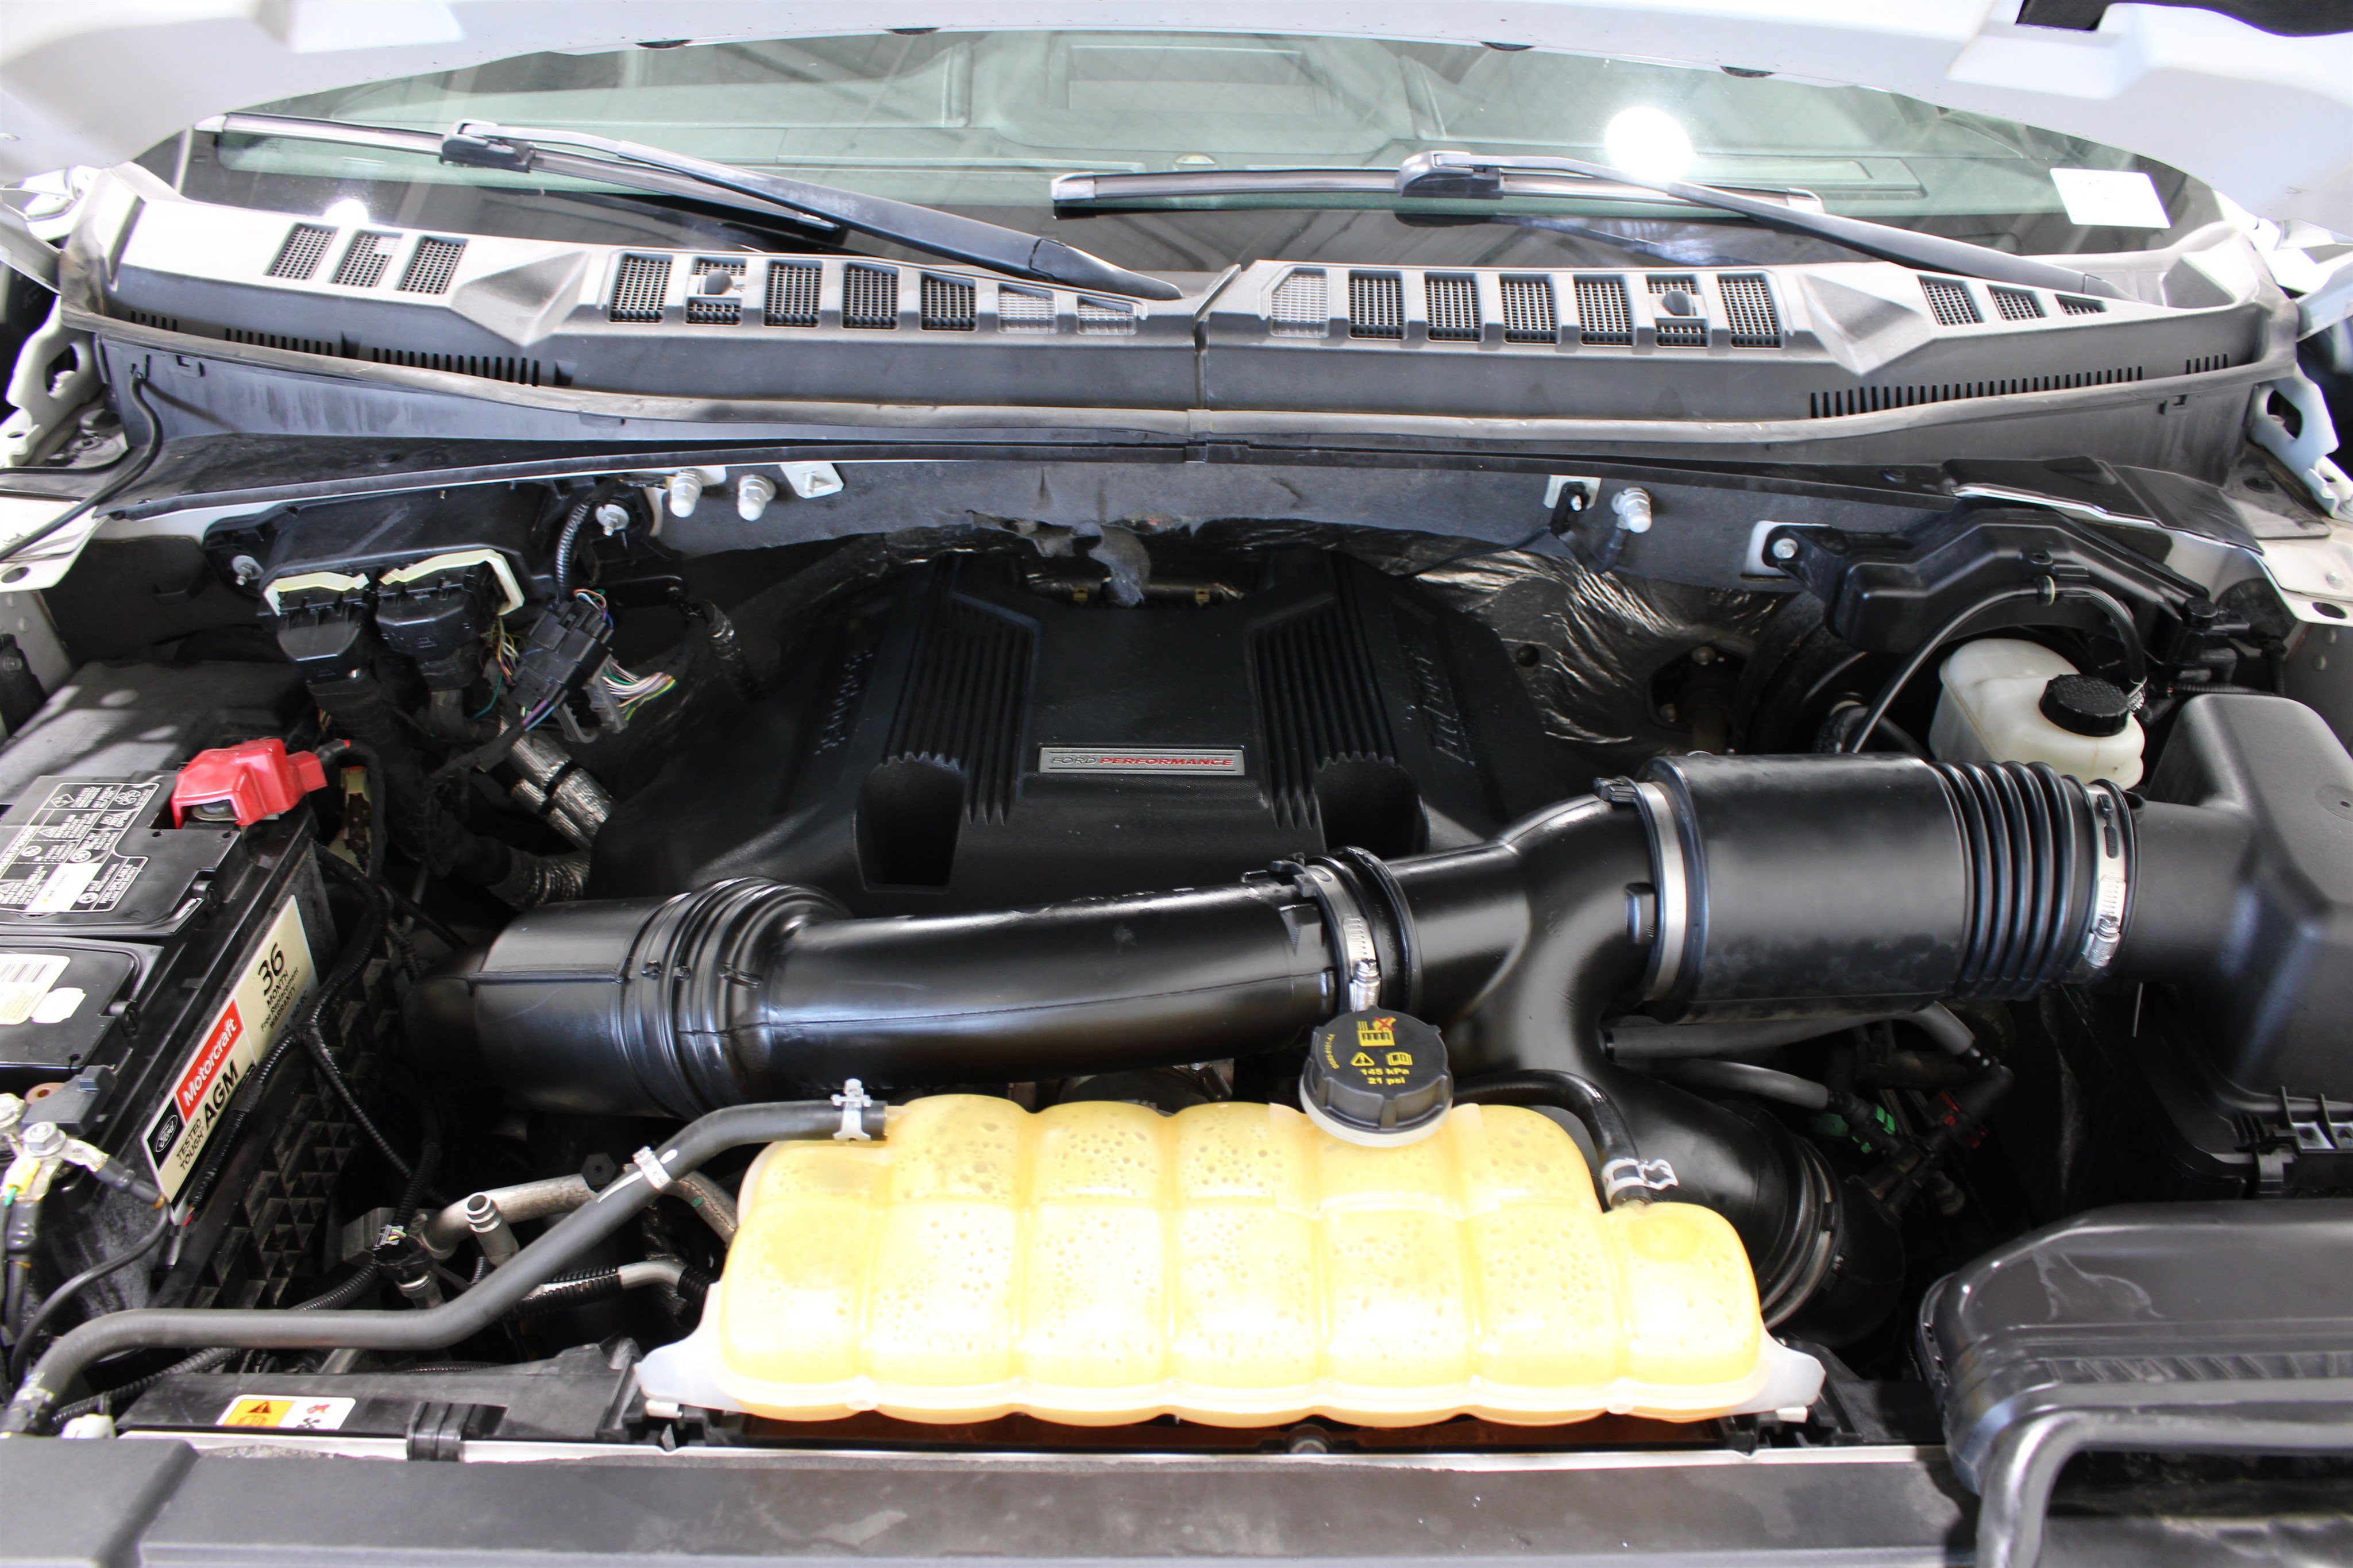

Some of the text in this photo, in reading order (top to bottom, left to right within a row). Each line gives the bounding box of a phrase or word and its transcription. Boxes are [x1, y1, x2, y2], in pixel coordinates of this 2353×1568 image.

[100, 816, 112, 824] DO
[108, 814, 121, 825] NOT
[94, 837, 107, 849] REACH
[99, 865, 133, 903] NON-SPILLABLE
[259, 941, 285, 997] 36
[261, 967, 299, 1032] Free Replacement
[267, 970, 289, 1009] MONTH
[270, 984, 295, 1029] WARRANTY
[183, 1017, 238, 1108] Motorcraft
[1367, 1076, 1406, 1086] 21 psi
[203, 1059, 240, 1129] AGM
[158, 1120, 174, 1148] Ford
[176, 1118, 202, 1160] TESTED
